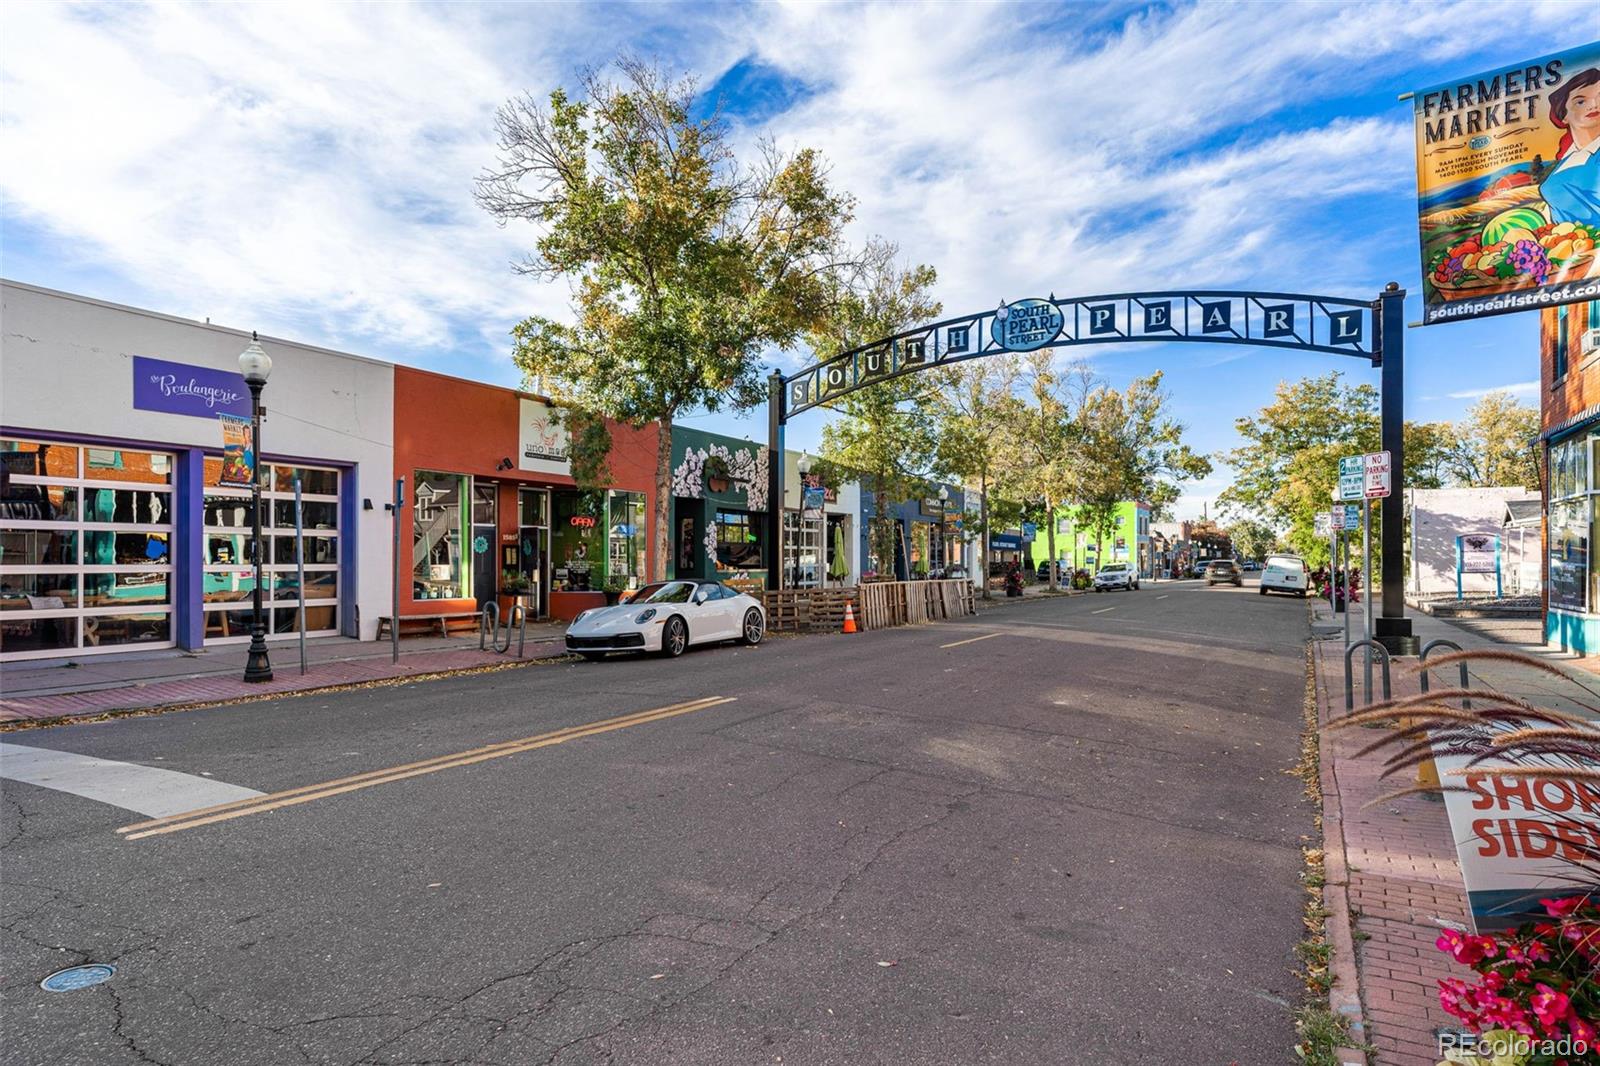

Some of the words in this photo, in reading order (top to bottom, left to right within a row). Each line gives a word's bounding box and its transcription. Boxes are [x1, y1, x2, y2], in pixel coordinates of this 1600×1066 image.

[1423, 59, 1563, 118] FARMERS
[1425, 94, 1540, 145] MARKET
[1435, 166, 1449, 174] MAY
[1451, 158, 1486, 169] THROUGH
[1488, 146, 1529, 161] NOVEMBER
[1470, 150, 1492, 160] EVERY
[1494, 142, 1523, 154] SUNDAY
[1475, 160, 1499, 171] SOUTH
[1501, 154, 1523, 164] PEARL
[1011, 305, 1050, 319] SOUTH
[1009, 315, 1058, 335] PEARL
[1009, 332, 1045, 345] STREET
[793, 330, 966, 397] SOUTH
[1094, 306, 1359, 338] PEARL
[160, 374, 244, 408] Boulangerie
[526, 444, 544, 453] uno
[1372, 455, 1382, 464] NO
[1366, 464, 1388, 474] PARKING
[570, 516, 595, 527] OPEN
[1472, 819, 1600, 860] SIDE
